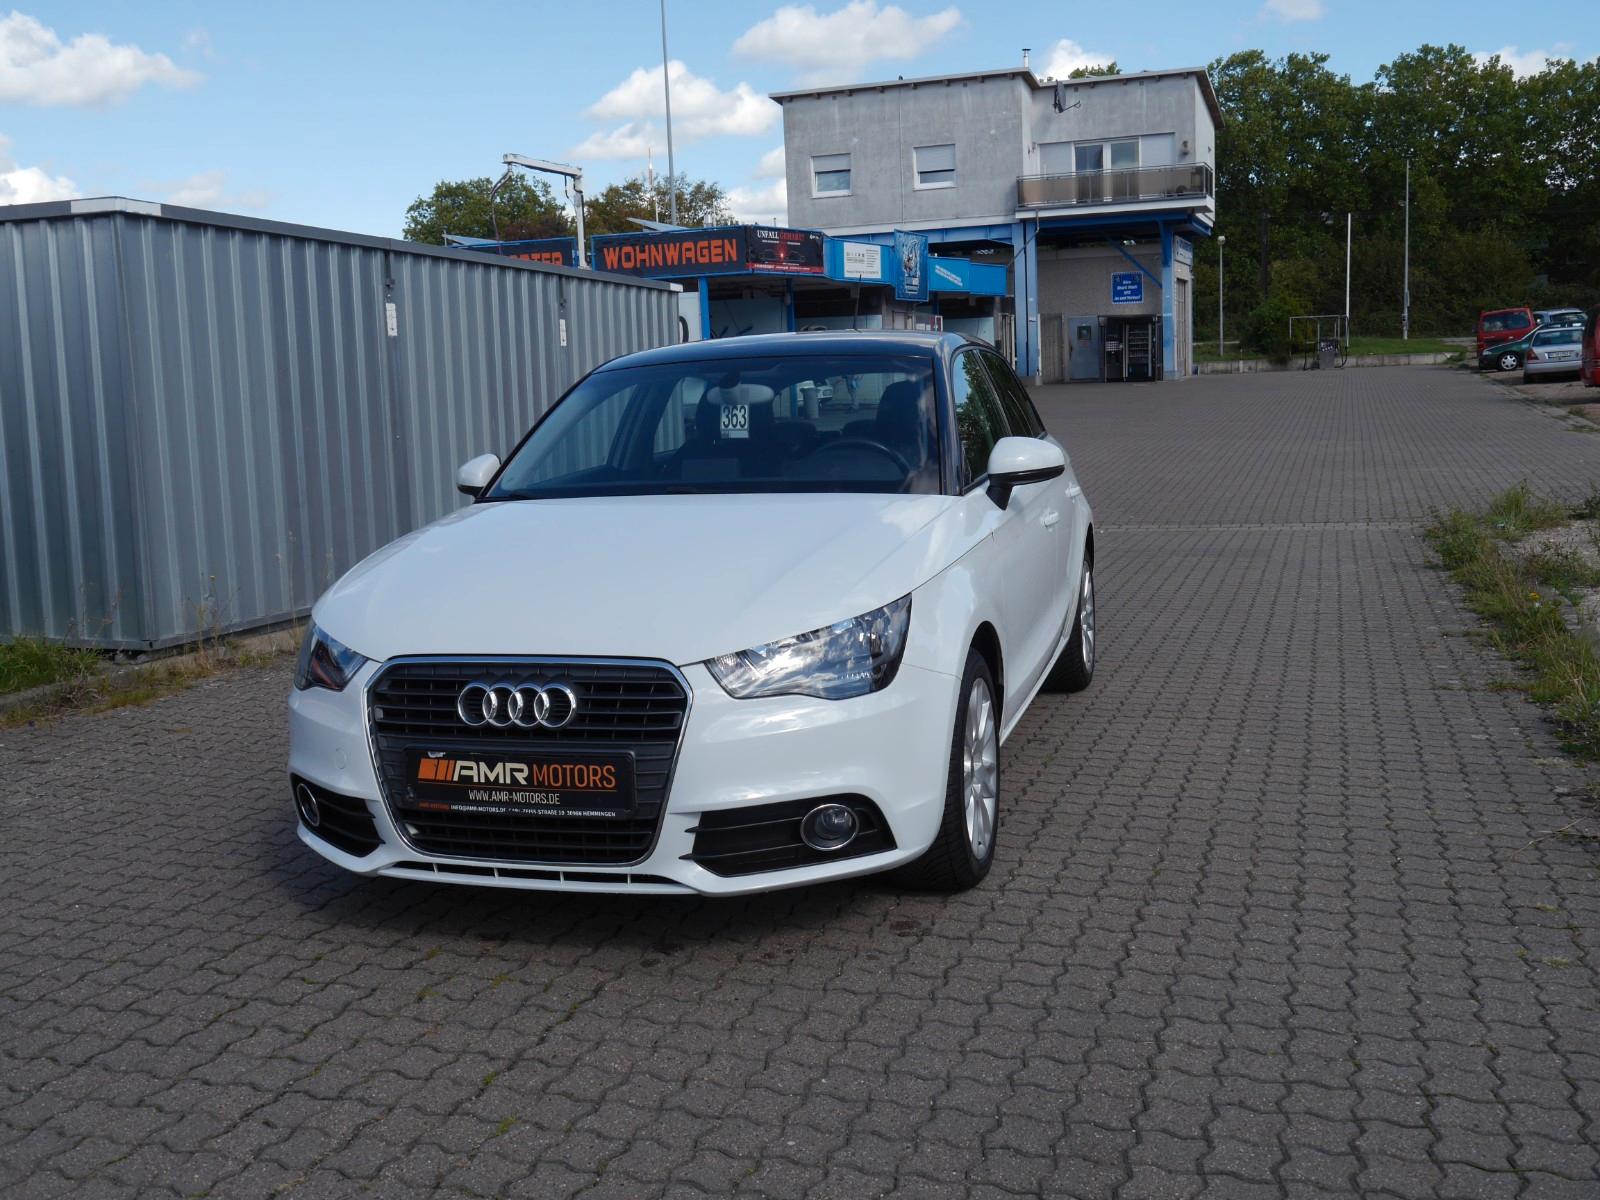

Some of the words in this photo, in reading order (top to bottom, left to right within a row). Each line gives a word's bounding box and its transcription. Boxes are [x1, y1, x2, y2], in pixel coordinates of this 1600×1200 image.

[757, 229, 779, 240] UNFALL
[603, 238, 738, 270] WOHNWAGEN
[722, 405, 747, 429] 363
[453, 760, 529, 785] AMR
[533, 763, 617, 788] MOTORS
[468, 789, 561, 805] WWW.AMR-MOTORS.DE
